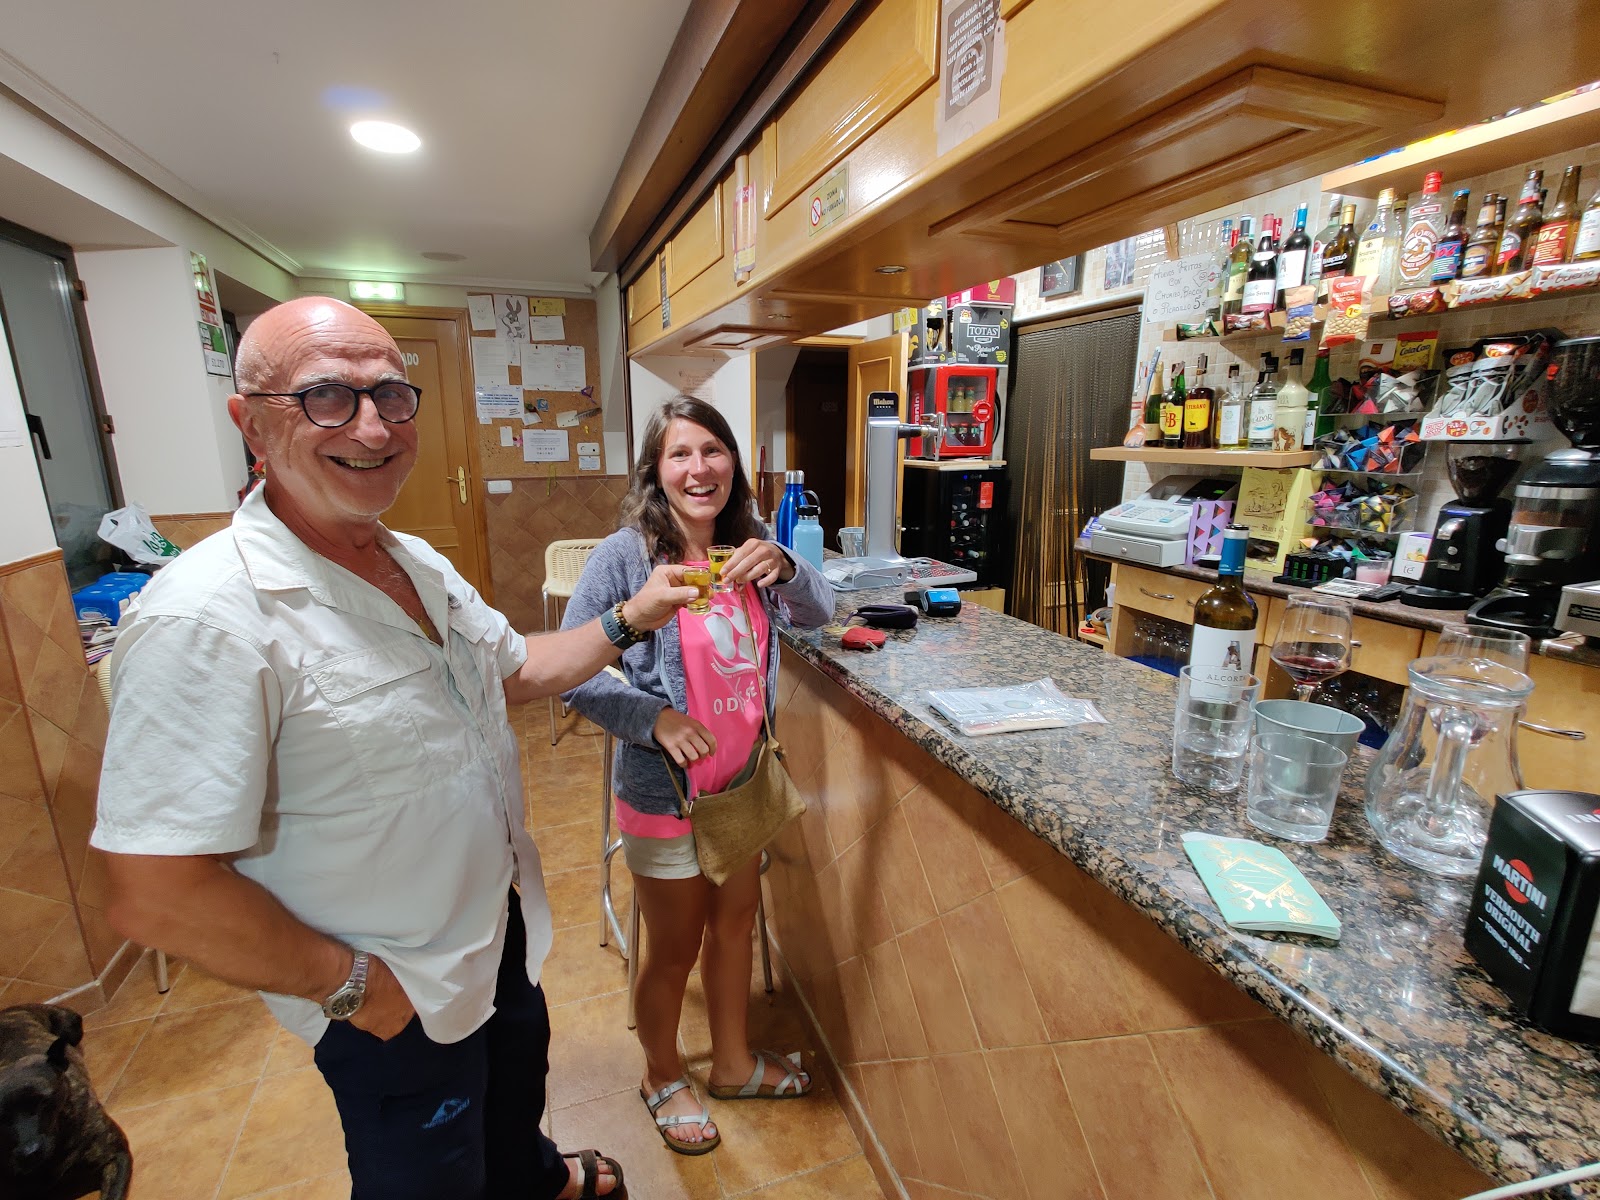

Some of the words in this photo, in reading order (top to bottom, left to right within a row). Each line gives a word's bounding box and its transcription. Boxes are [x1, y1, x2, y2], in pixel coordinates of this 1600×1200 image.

[969, 326, 999, 336] TOTAS
[1399, 344, 1431, 357] ColaCao
[1492, 853, 1548, 911] MARTINI
[1484, 883, 1541, 945] VERMOUTH
[1484, 900, 1532, 954] ORIGINAL
